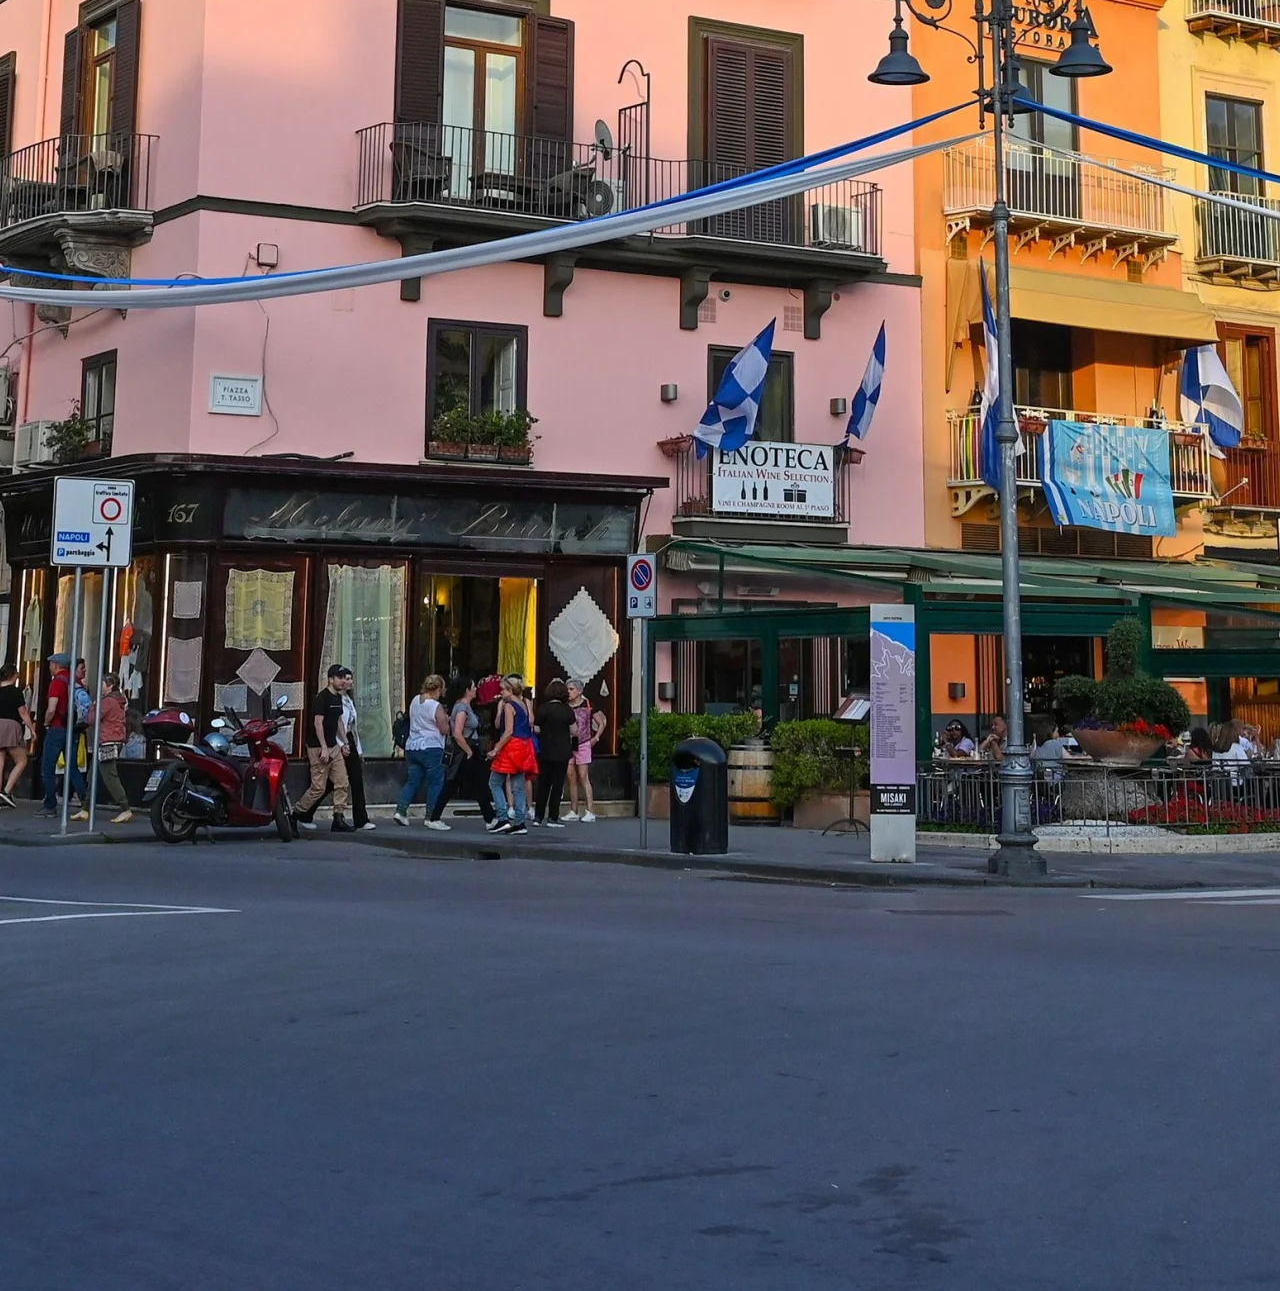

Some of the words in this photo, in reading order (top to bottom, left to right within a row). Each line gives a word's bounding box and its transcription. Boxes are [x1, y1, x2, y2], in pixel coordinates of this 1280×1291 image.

[1006, 5, 1099, 39] URORA
[223, 386, 249, 394] PIAZZA
[229, 394, 251, 402] TASSO
[718, 445, 830, 471] ENOTECA
[718, 466, 753, 479] ITALIAN
[756, 468, 781, 480] WINE
[783, 470, 829, 483] SELECTION
[167, 503, 200, 523] 167
[1076, 497, 1157, 527] NAPOLI
[58, 533, 88, 541] NAPOLI
[66, 549, 95, 557] parcheggio
[880, 792, 907, 803] MISAKI
